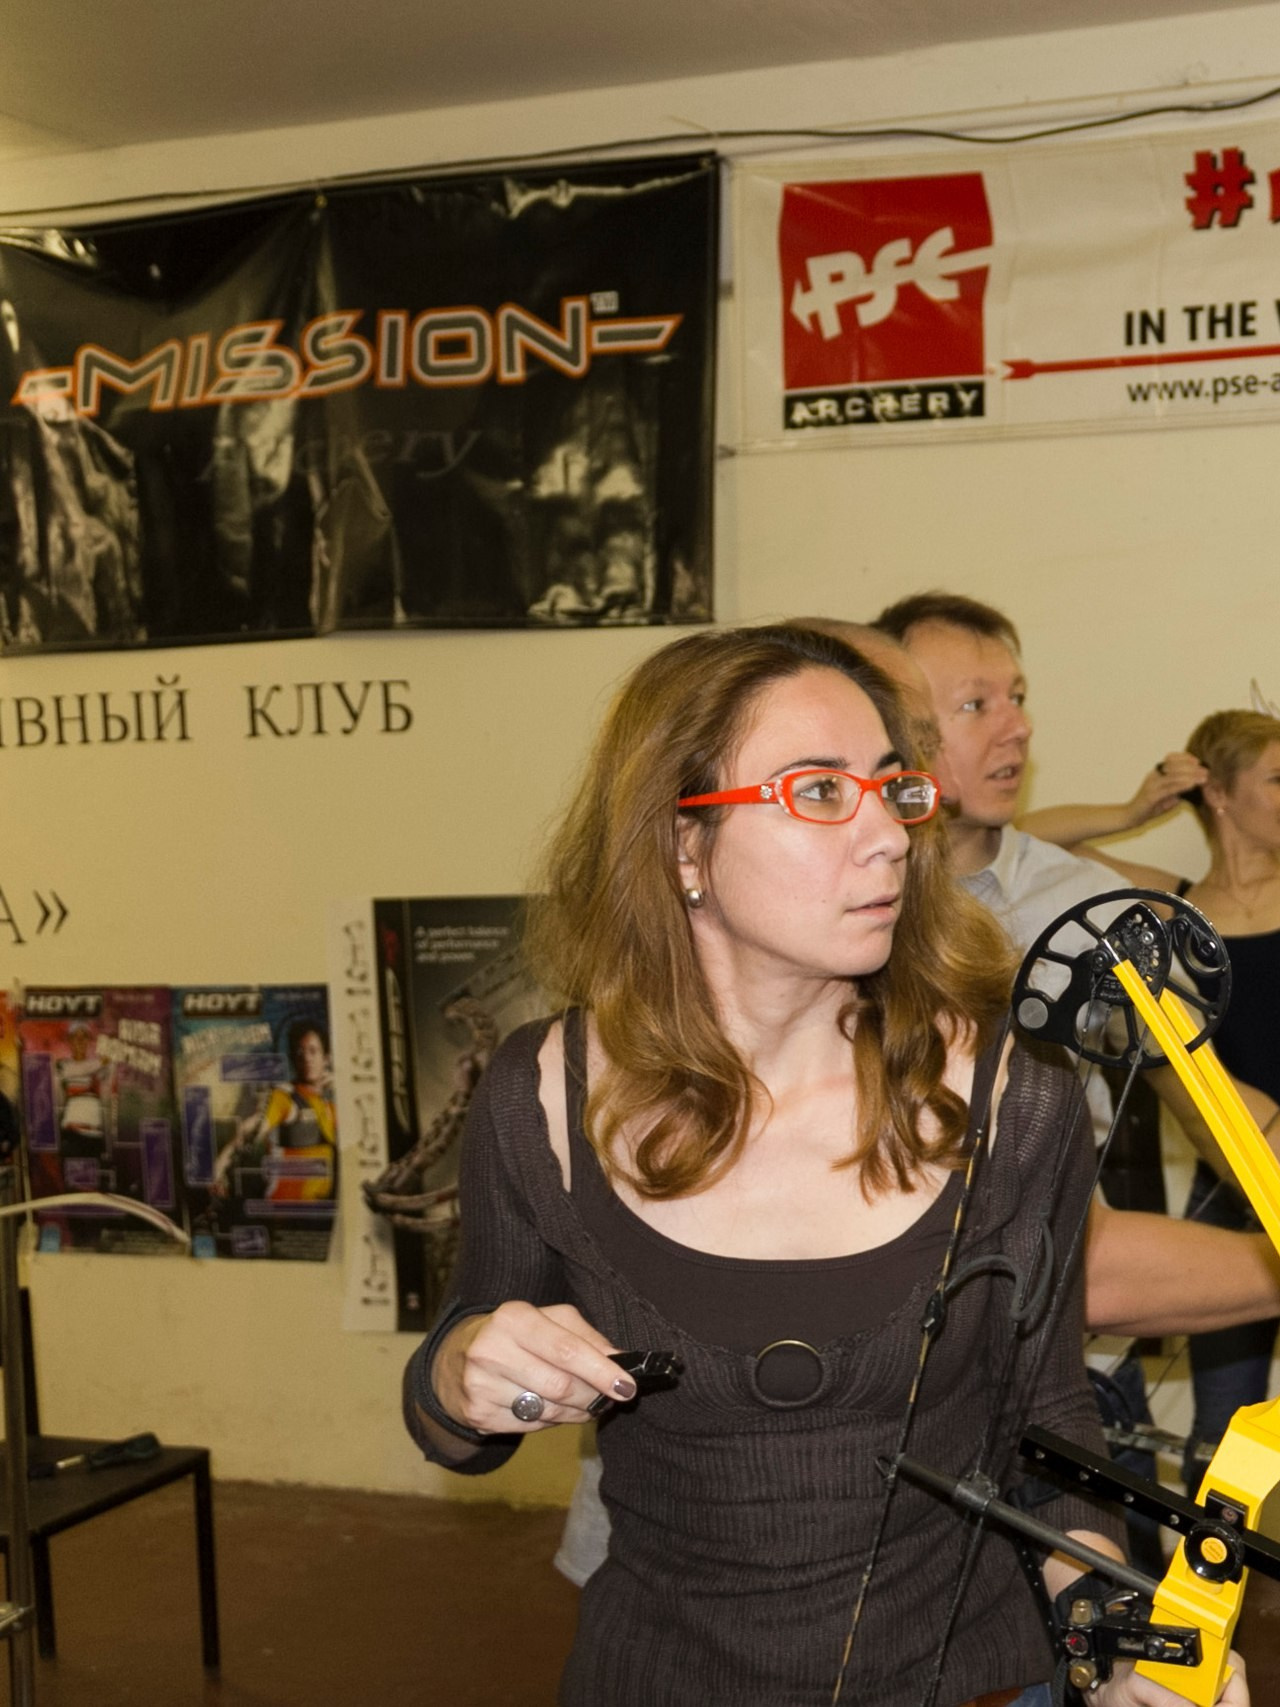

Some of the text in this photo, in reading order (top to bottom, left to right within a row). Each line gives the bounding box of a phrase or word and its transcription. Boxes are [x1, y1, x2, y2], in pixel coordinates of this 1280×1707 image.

[1125, 309, 1166, 346] IN
[1183, 301, 1257, 341] THE
[74, 296, 590, 418] MISSION
[790, 390, 978, 424] ARCHERY
[0, 674, 413, 748] ВНЫЙ КЛУБ
[26, 995, 101, 1012] HOYT
[183, 992, 260, 1010] HOYT
